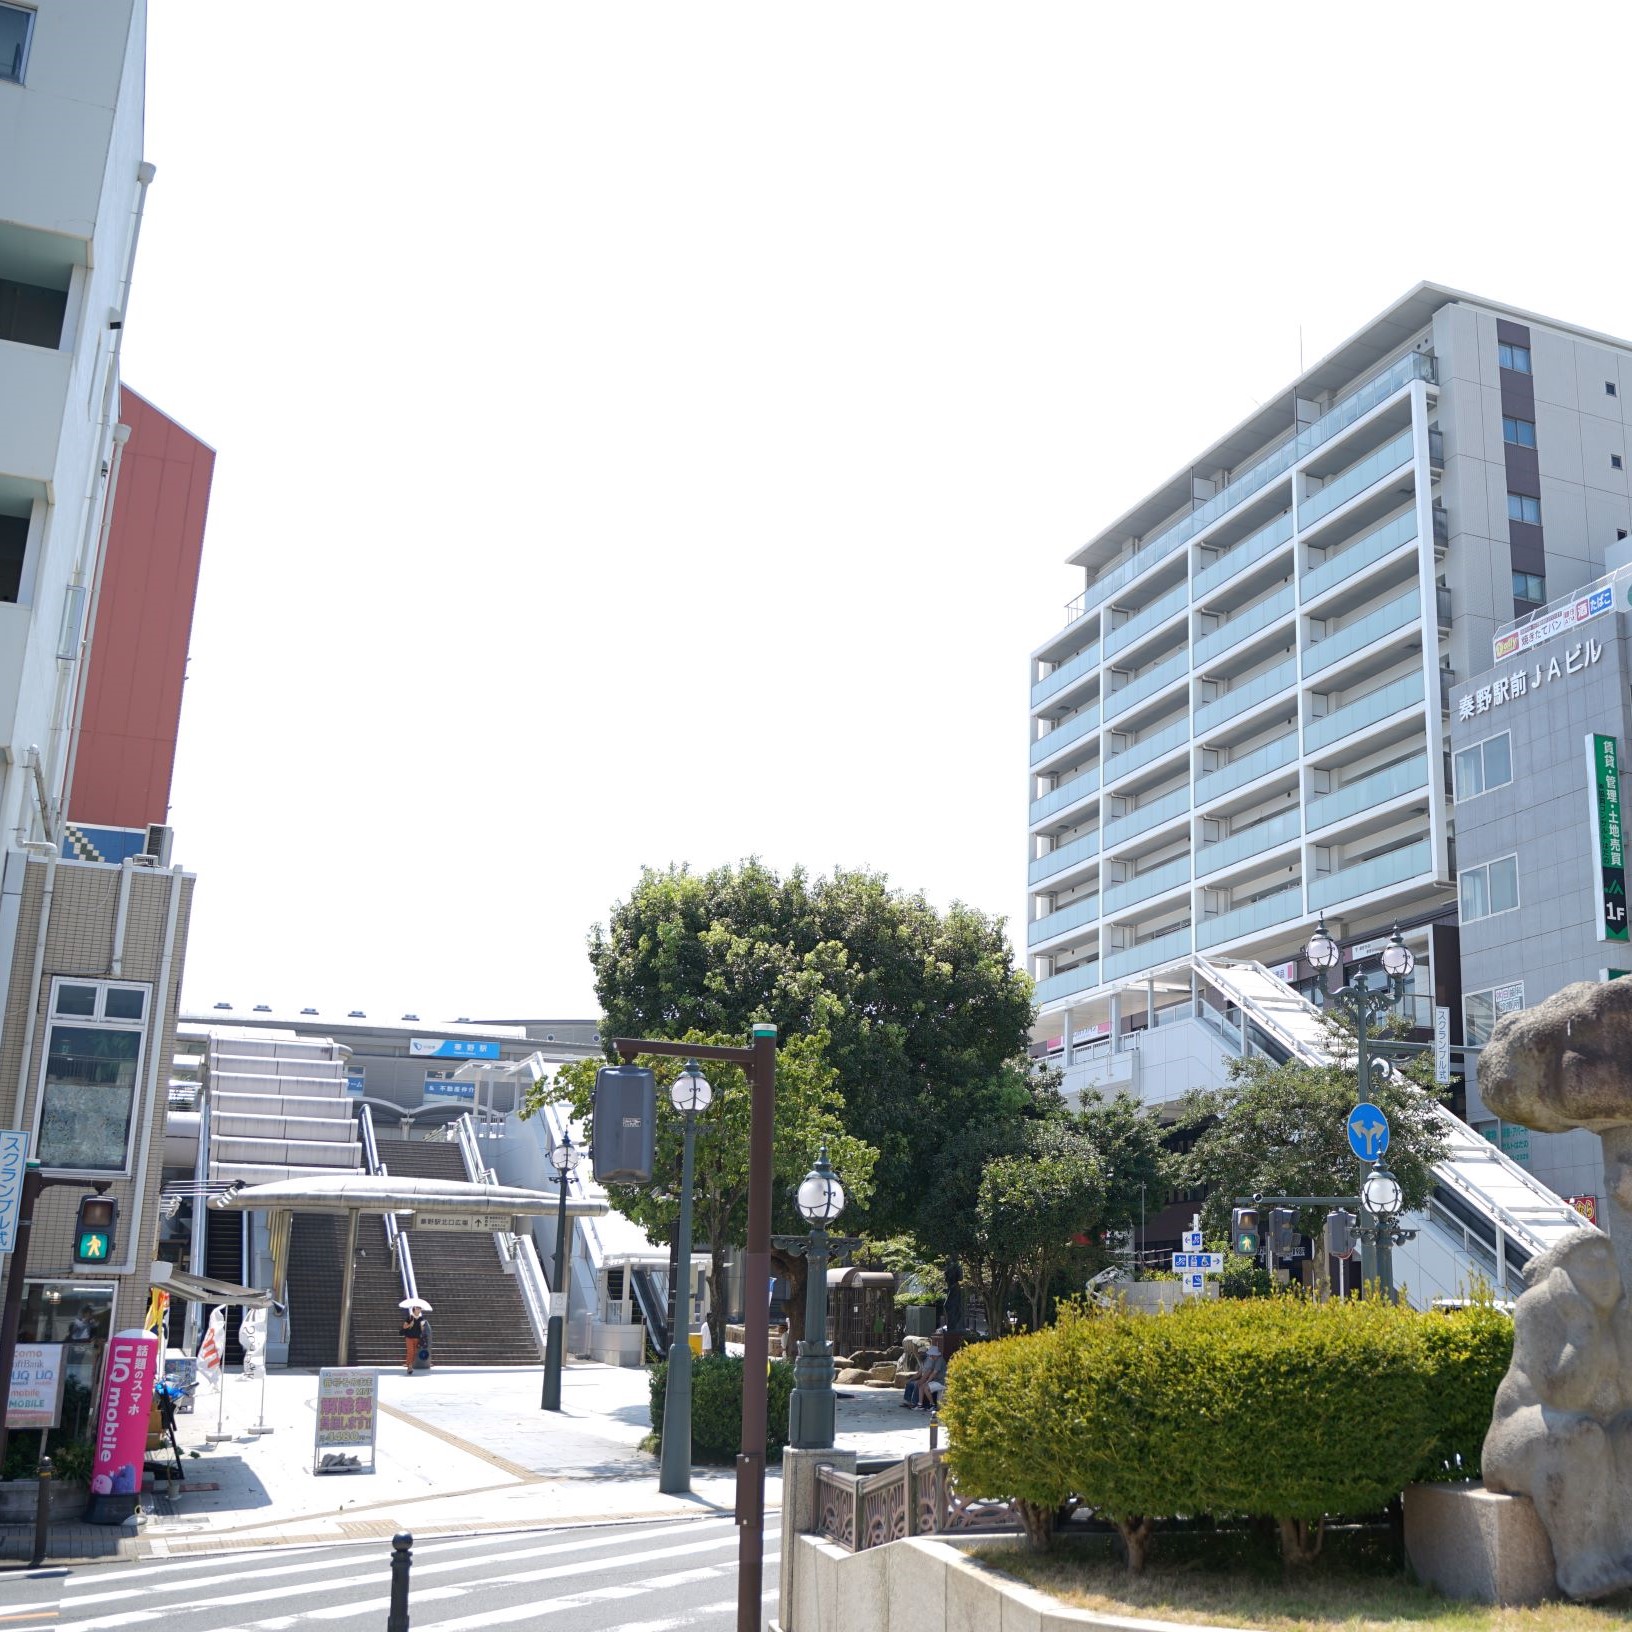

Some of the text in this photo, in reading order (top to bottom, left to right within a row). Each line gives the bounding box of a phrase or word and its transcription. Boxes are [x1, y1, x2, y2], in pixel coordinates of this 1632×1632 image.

[1589, 592, 1612, 614] たばこ
[1521, 619, 1562, 647] 焼きたてパン
[1606, 901, 1625, 921] 1F
[128, 1344, 149, 1417] 話題のスマホ
[100, 1345, 133, 1463] UQ mobile
